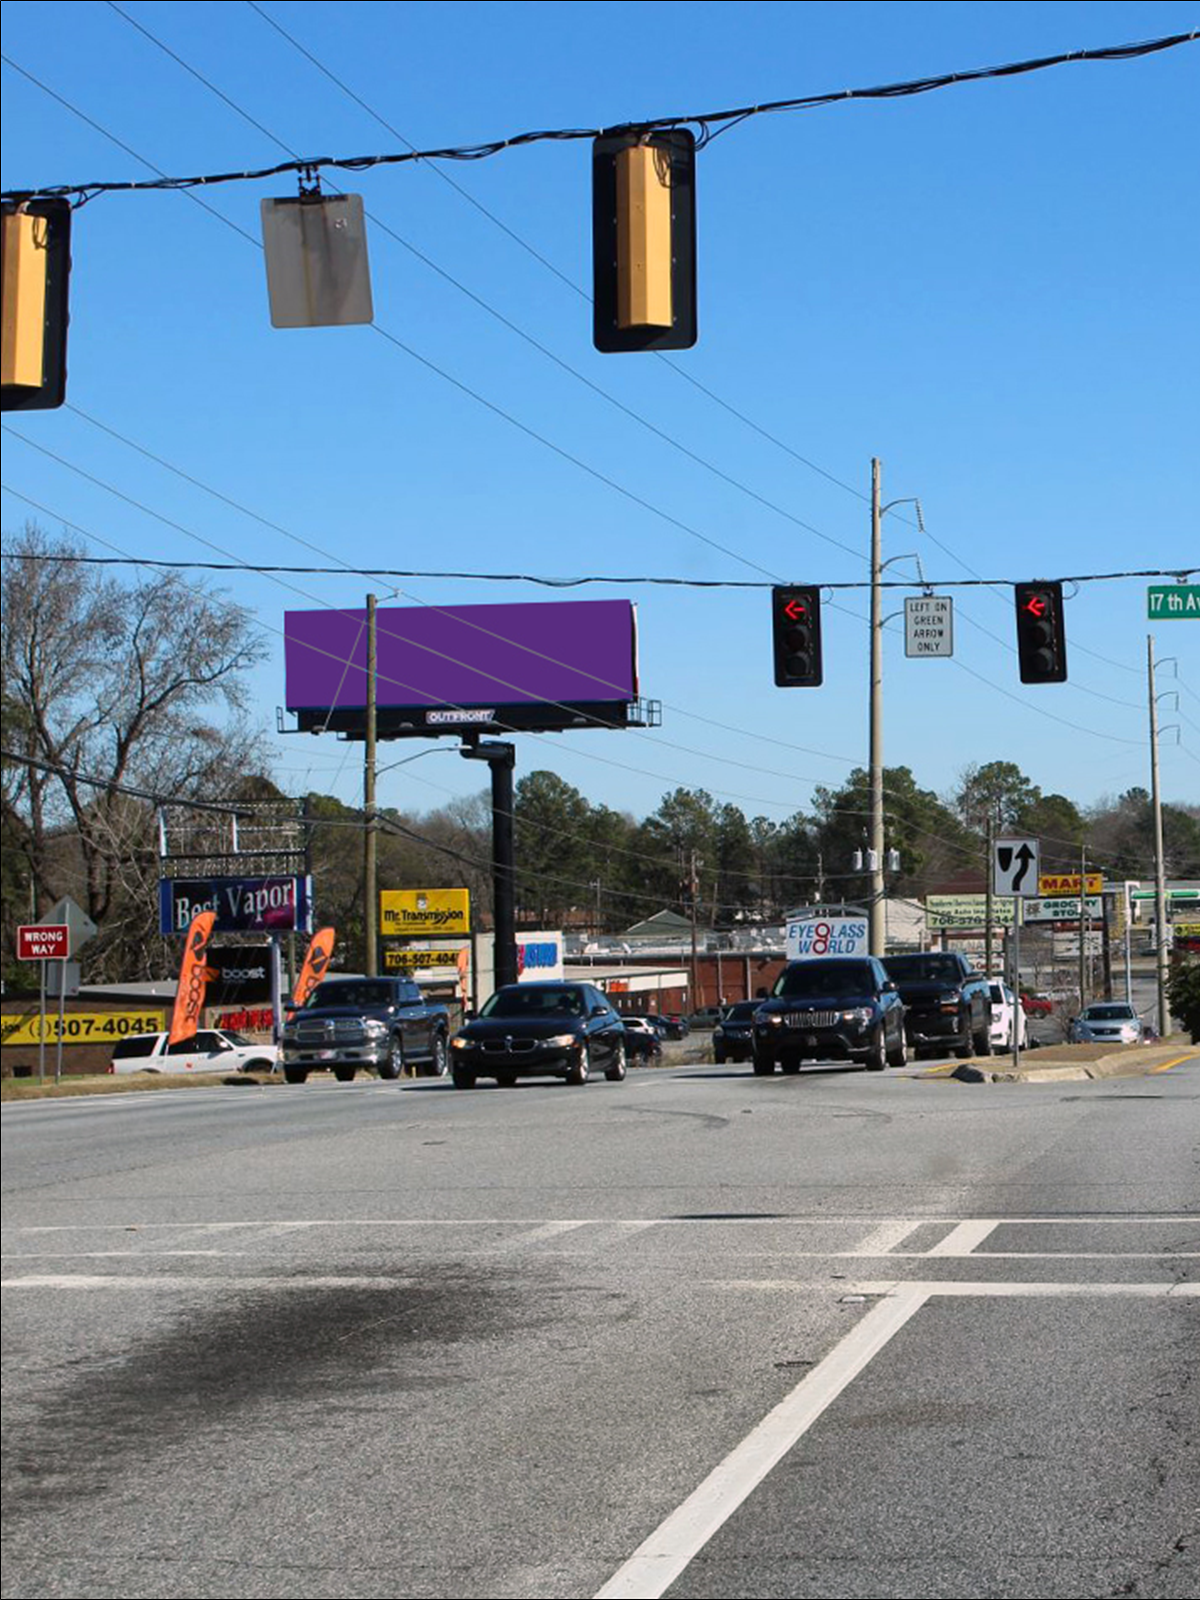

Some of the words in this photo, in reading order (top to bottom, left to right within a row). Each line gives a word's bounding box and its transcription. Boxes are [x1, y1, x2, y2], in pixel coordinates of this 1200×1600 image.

[910, 602, 929, 612] LEFT
[934, 602, 947, 612] ON
[914, 615, 943, 625] GREEN
[914, 629, 943, 639] ARROW
[917, 642, 940, 652] ONLY
[428, 710, 492, 722] OUTFRONT
[1043, 877, 1098, 890] MART
[175, 893, 221, 930] Best
[225, 881, 292, 922] Vapor
[401, 908, 464, 925] Transmission
[789, 923, 866, 939] EYEGLASS
[24, 932, 63, 943] WRONG
[31, 944, 55, 955] WAY
[799, 939, 856, 955] WORLD
[222, 966, 266, 979] boost
